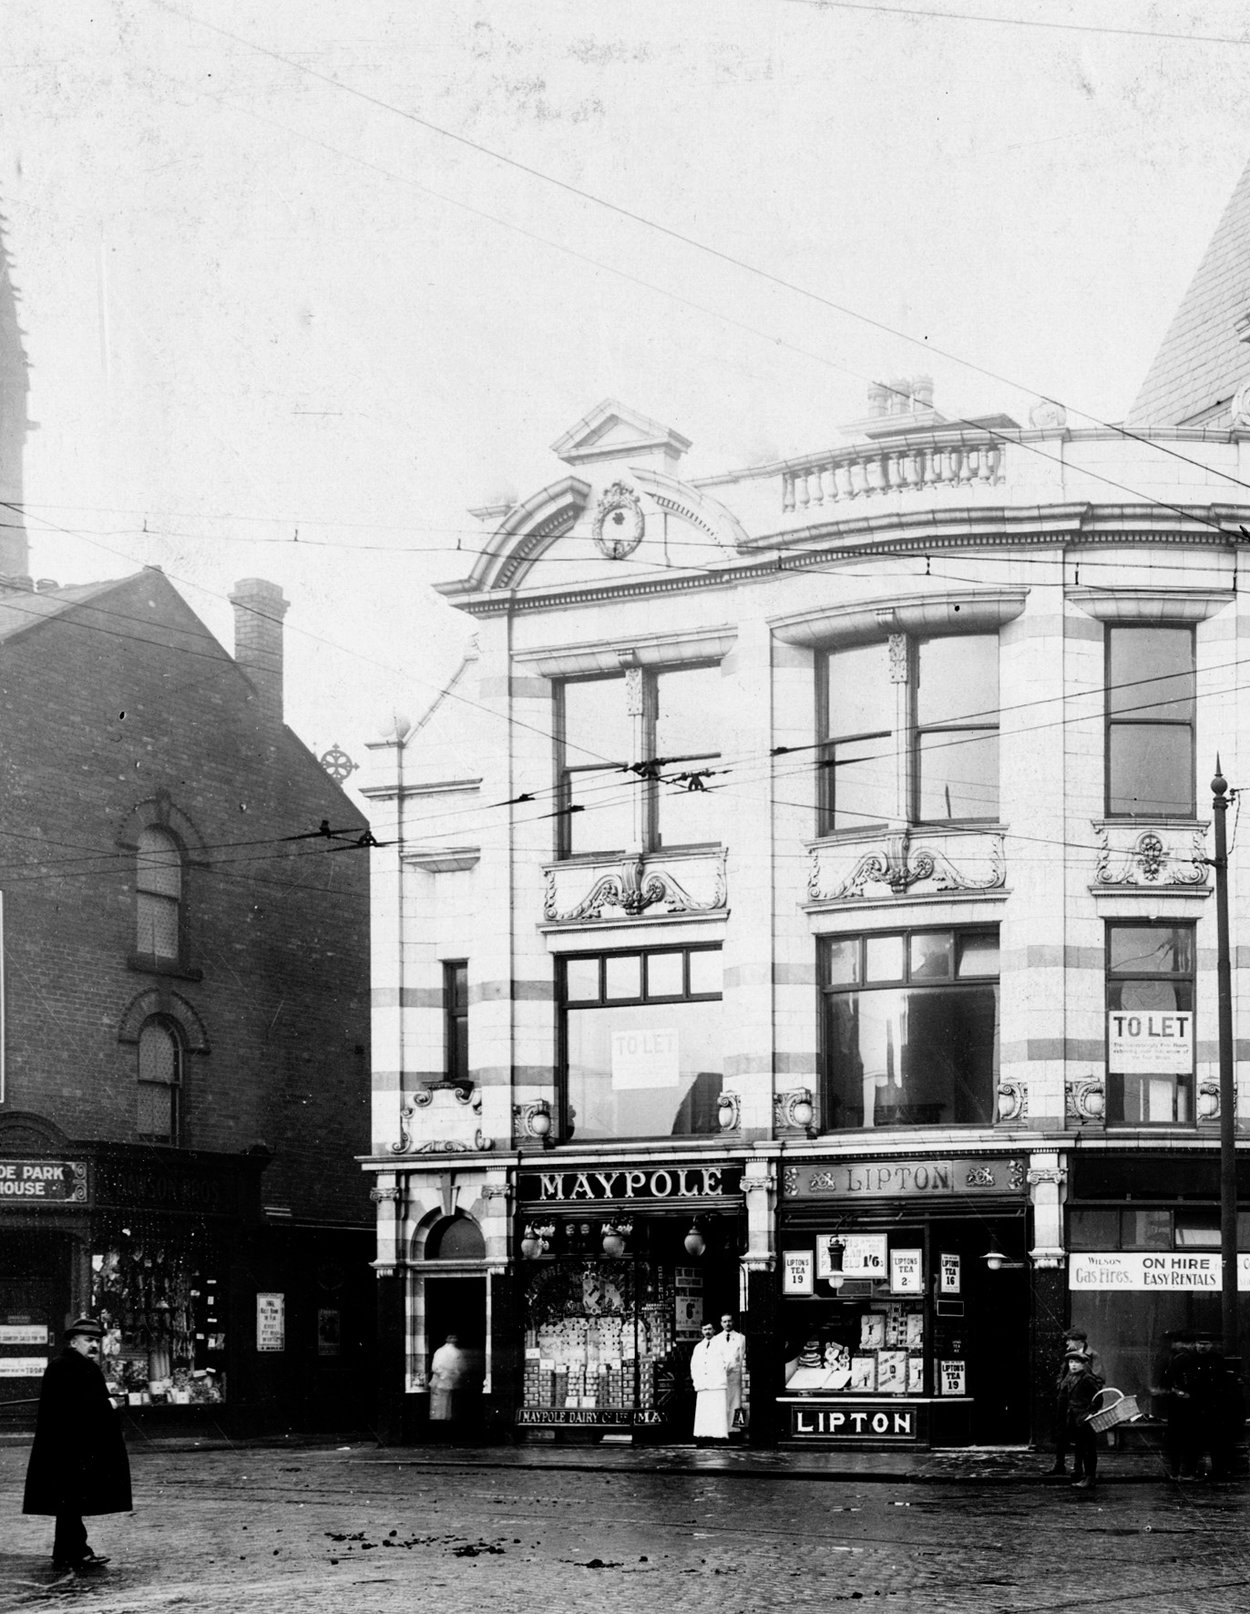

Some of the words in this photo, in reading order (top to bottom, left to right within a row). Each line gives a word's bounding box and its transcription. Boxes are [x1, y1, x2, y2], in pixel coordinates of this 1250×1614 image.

[1113, 1016, 1141, 1037] TO
[1148, 1016, 1189, 1037] LET
[615, 1035, 637, 1055] TO
[643, 1033, 675, 1053] LET
[23, 1166, 64, 1180] PARK
[847, 1166, 949, 1192] LIPTON
[539, 1168, 723, 1200] MAYPOLE
[898, 1265, 914, 1273] TEA
[1143, 1258, 1166, 1269] ON
[1171, 1259, 1210, 1270] HIRE
[944, 1267, 957, 1276] TEA
[1076, 1268, 1097, 1284] Gas
[1144, 1272, 1168, 1286] EASY
[1171, 1271, 1217, 1286] RENTALS
[793, 1275, 803, 1284] 19
[946, 1372, 961, 1380] TEA
[948, 1380, 959, 1390] 19
[522, 1411, 566, 1423] MAYPOLE
[569, 1411, 599, 1423] DAIRY
[638, 1411, 668, 1424] MA
[797, 1412, 911, 1433] LIPTON
